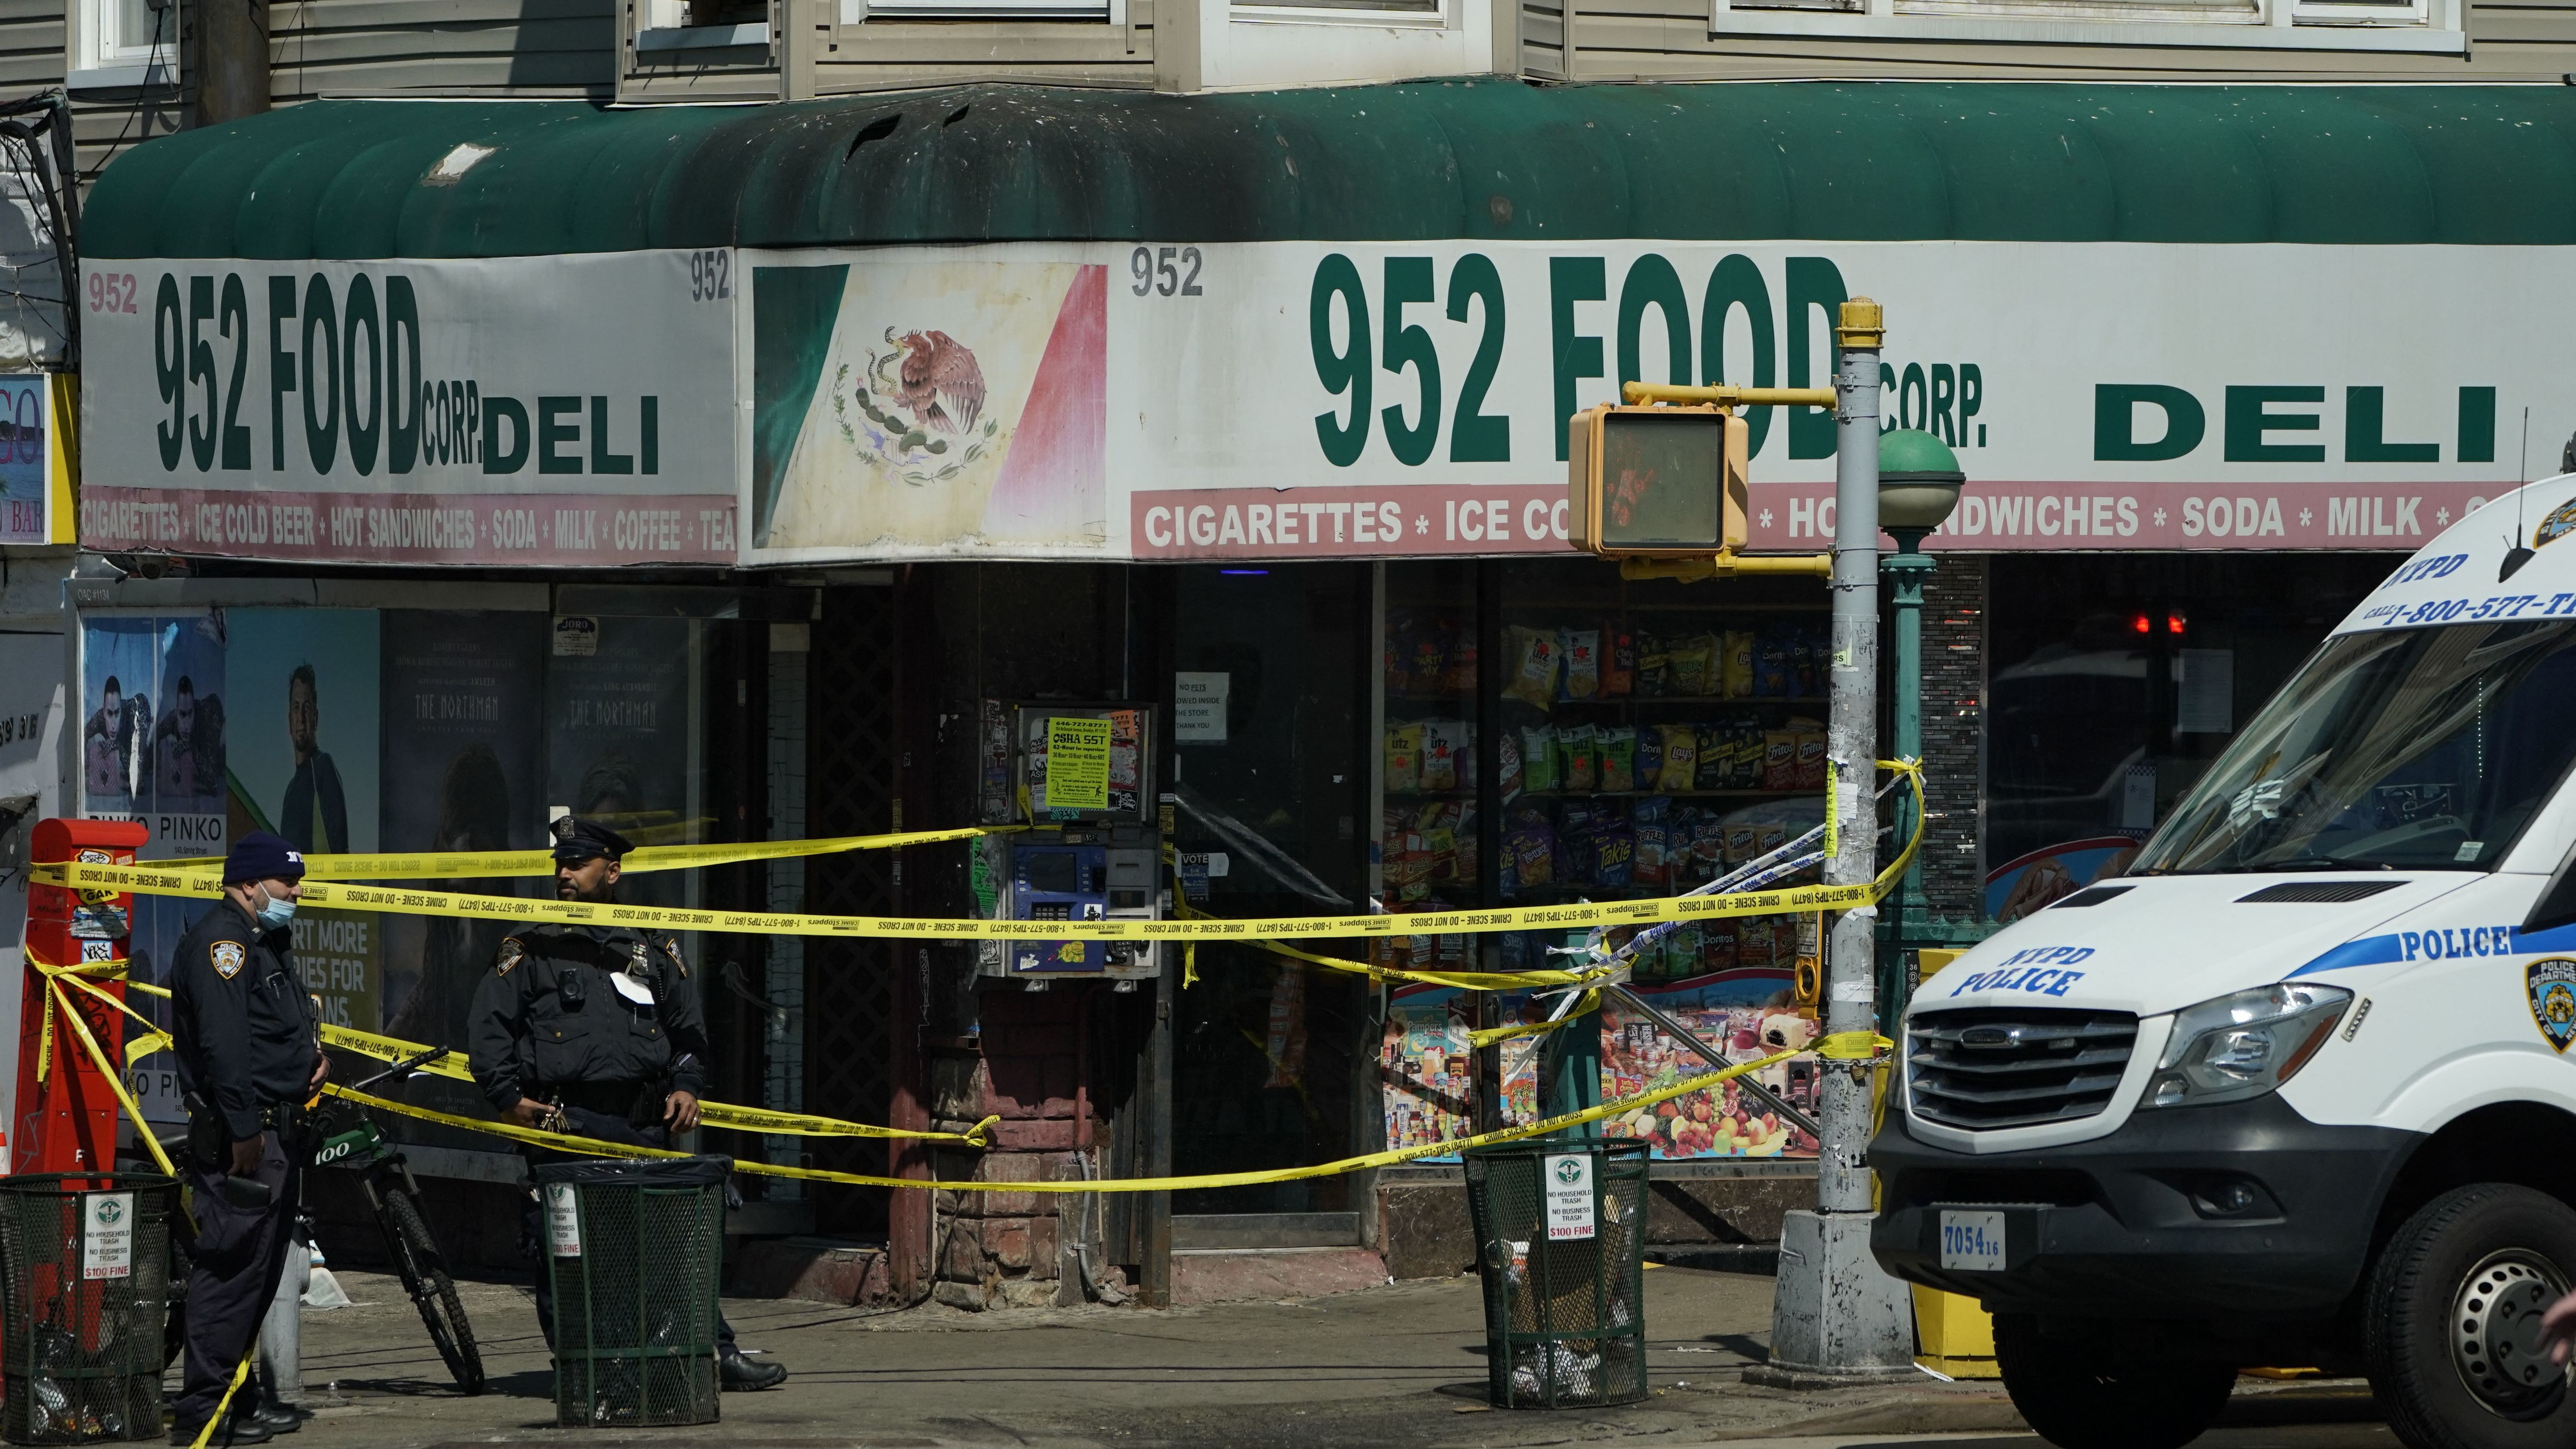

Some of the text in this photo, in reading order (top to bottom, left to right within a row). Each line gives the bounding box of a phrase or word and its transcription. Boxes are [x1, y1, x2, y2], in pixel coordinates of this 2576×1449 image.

[692, 249, 729, 302] 952
[1131, 246, 1203, 296] 952
[89, 273, 137, 314] 952
[1310, 253, 2496, 467] 952 FOOD CORP. DELI
[155, 272, 659, 477] 952 FOOD CORP. DELI
[82, 499, 734, 551] CIGARETTES ICE COLD BEER HOT SANDWICHES SODA MILK COFFEE TEA
[1144, 497, 2422, 547] CIGARETTES ICE SODA MILK
[2381, 554, 2468, 590] NYPD
[415, 694, 498, 721] THE NORTHMAN
[570, 700, 656, 726] THE NORTHMAN
[1053, 733, 1105, 744] OSHA SST
[1672, 746, 1694, 761] Lay's
[1702, 748, 1732, 761] Smartfood
[1768, 742, 1794, 760] Fritos
[1799, 741, 1824, 760] Fritos
[160, 817, 221, 841] PINKO
[1730, 830, 1754, 849] Fritos
[1761, 830, 1785, 850] Fritos
[1182, 854, 1208, 864] VOTE
[1599, 839, 1631, 871] Takis
[80, 869, 181, 888] CRIME SCENE DO NOT CROSS
[1699, 867, 1710, 876] BBQ
[459, 898, 592, 914] CRIMEStoppers 1-800-577-TIPS (8477)
[1607, 889, 1865, 914] 1-800-577-TIPS (8477) CRIME SCENE DO NOT CROSS CRIMEStoppers
[319, 921, 367, 954] MORE
[1704, 933, 1734, 945] Doritos
[2401, 926, 2509, 962] POLICE
[1998, 947, 2095, 967] NYPD
[2541, 961, 2576, 973] POLICE
[331, 960, 365, 992] FOR
[1950, 967, 2085, 998] POLICE
[2532, 999, 2545, 1021] CITY
[1407, 1021, 1443, 1033] Pampers
[1448, 1026, 1469, 1048] Marlboro
[335, 1033, 354, 1046] (8477)
[355, 1036, 400, 1056] 1-800-577-TIPS
[1452, 1139, 1473, 1152] (8477)
[1484, 1128, 1505, 1143] CRIME
[1506, 1125, 1528, 1138] SCENE
[1536, 1120, 1545, 1129] DO
[1546, 1117, 1560, 1126] NOT
[1561, 1111, 1583, 1123] CROSS
[316, 1142, 349, 1165] 100
[1557, 1189, 1591, 1197] HOUSEHOLD
[1550, 1225, 1594, 1237] $100 FINE
[1945, 1226, 1999, 1256] 7054 16
[565, 1244, 580, 1253] FINE
[85, 1265, 129, 1277] $100 FINE
